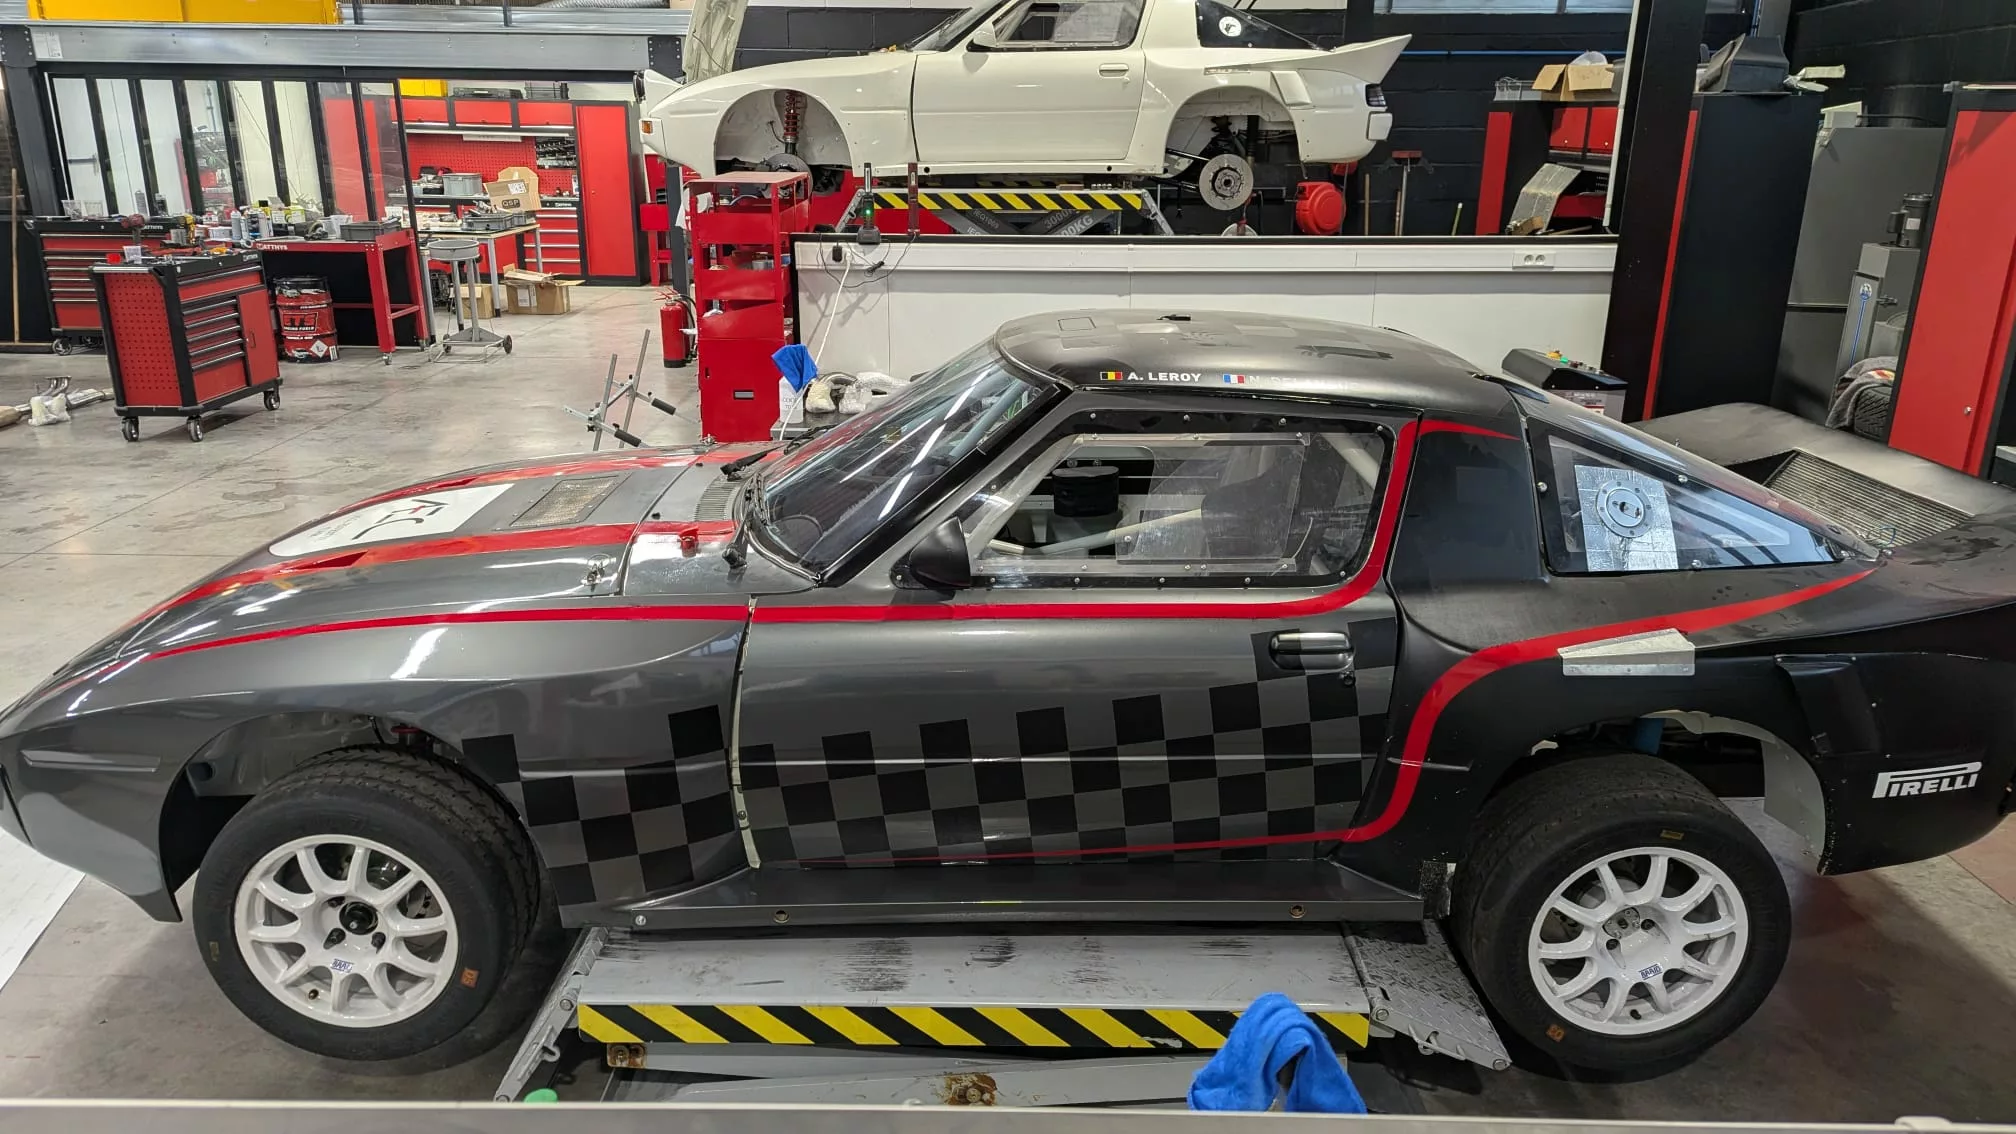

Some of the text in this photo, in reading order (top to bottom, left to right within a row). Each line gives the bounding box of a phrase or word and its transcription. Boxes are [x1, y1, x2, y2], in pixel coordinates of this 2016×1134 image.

[1127, 372, 1201, 382] A. LEROY
[1872, 761, 1982, 799] PIRELLI
